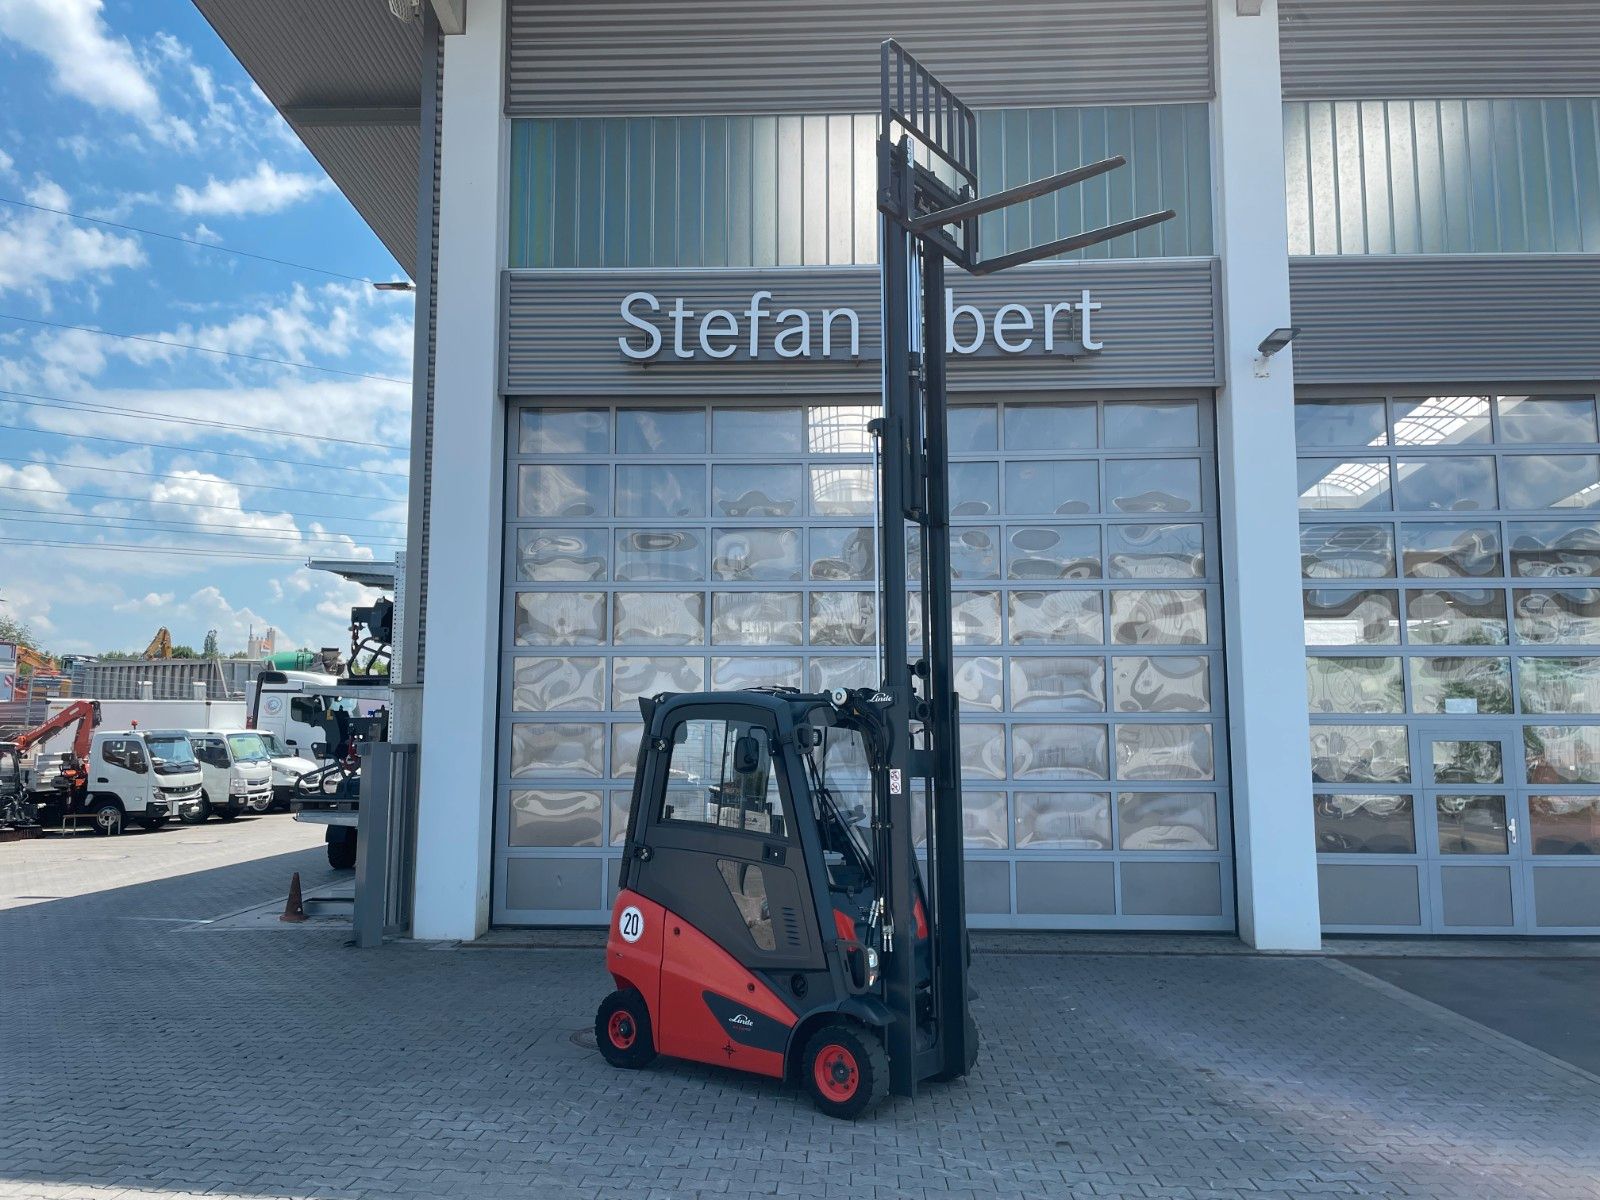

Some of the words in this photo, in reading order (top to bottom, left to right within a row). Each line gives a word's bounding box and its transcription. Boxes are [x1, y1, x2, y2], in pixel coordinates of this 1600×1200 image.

[618, 291, 859, 358] Stefan
[945, 289, 1104, 354] bert
[868, 693, 892, 702] Linde
[624, 912, 639, 936] 20
[728, 1013, 754, 1026] Linde
